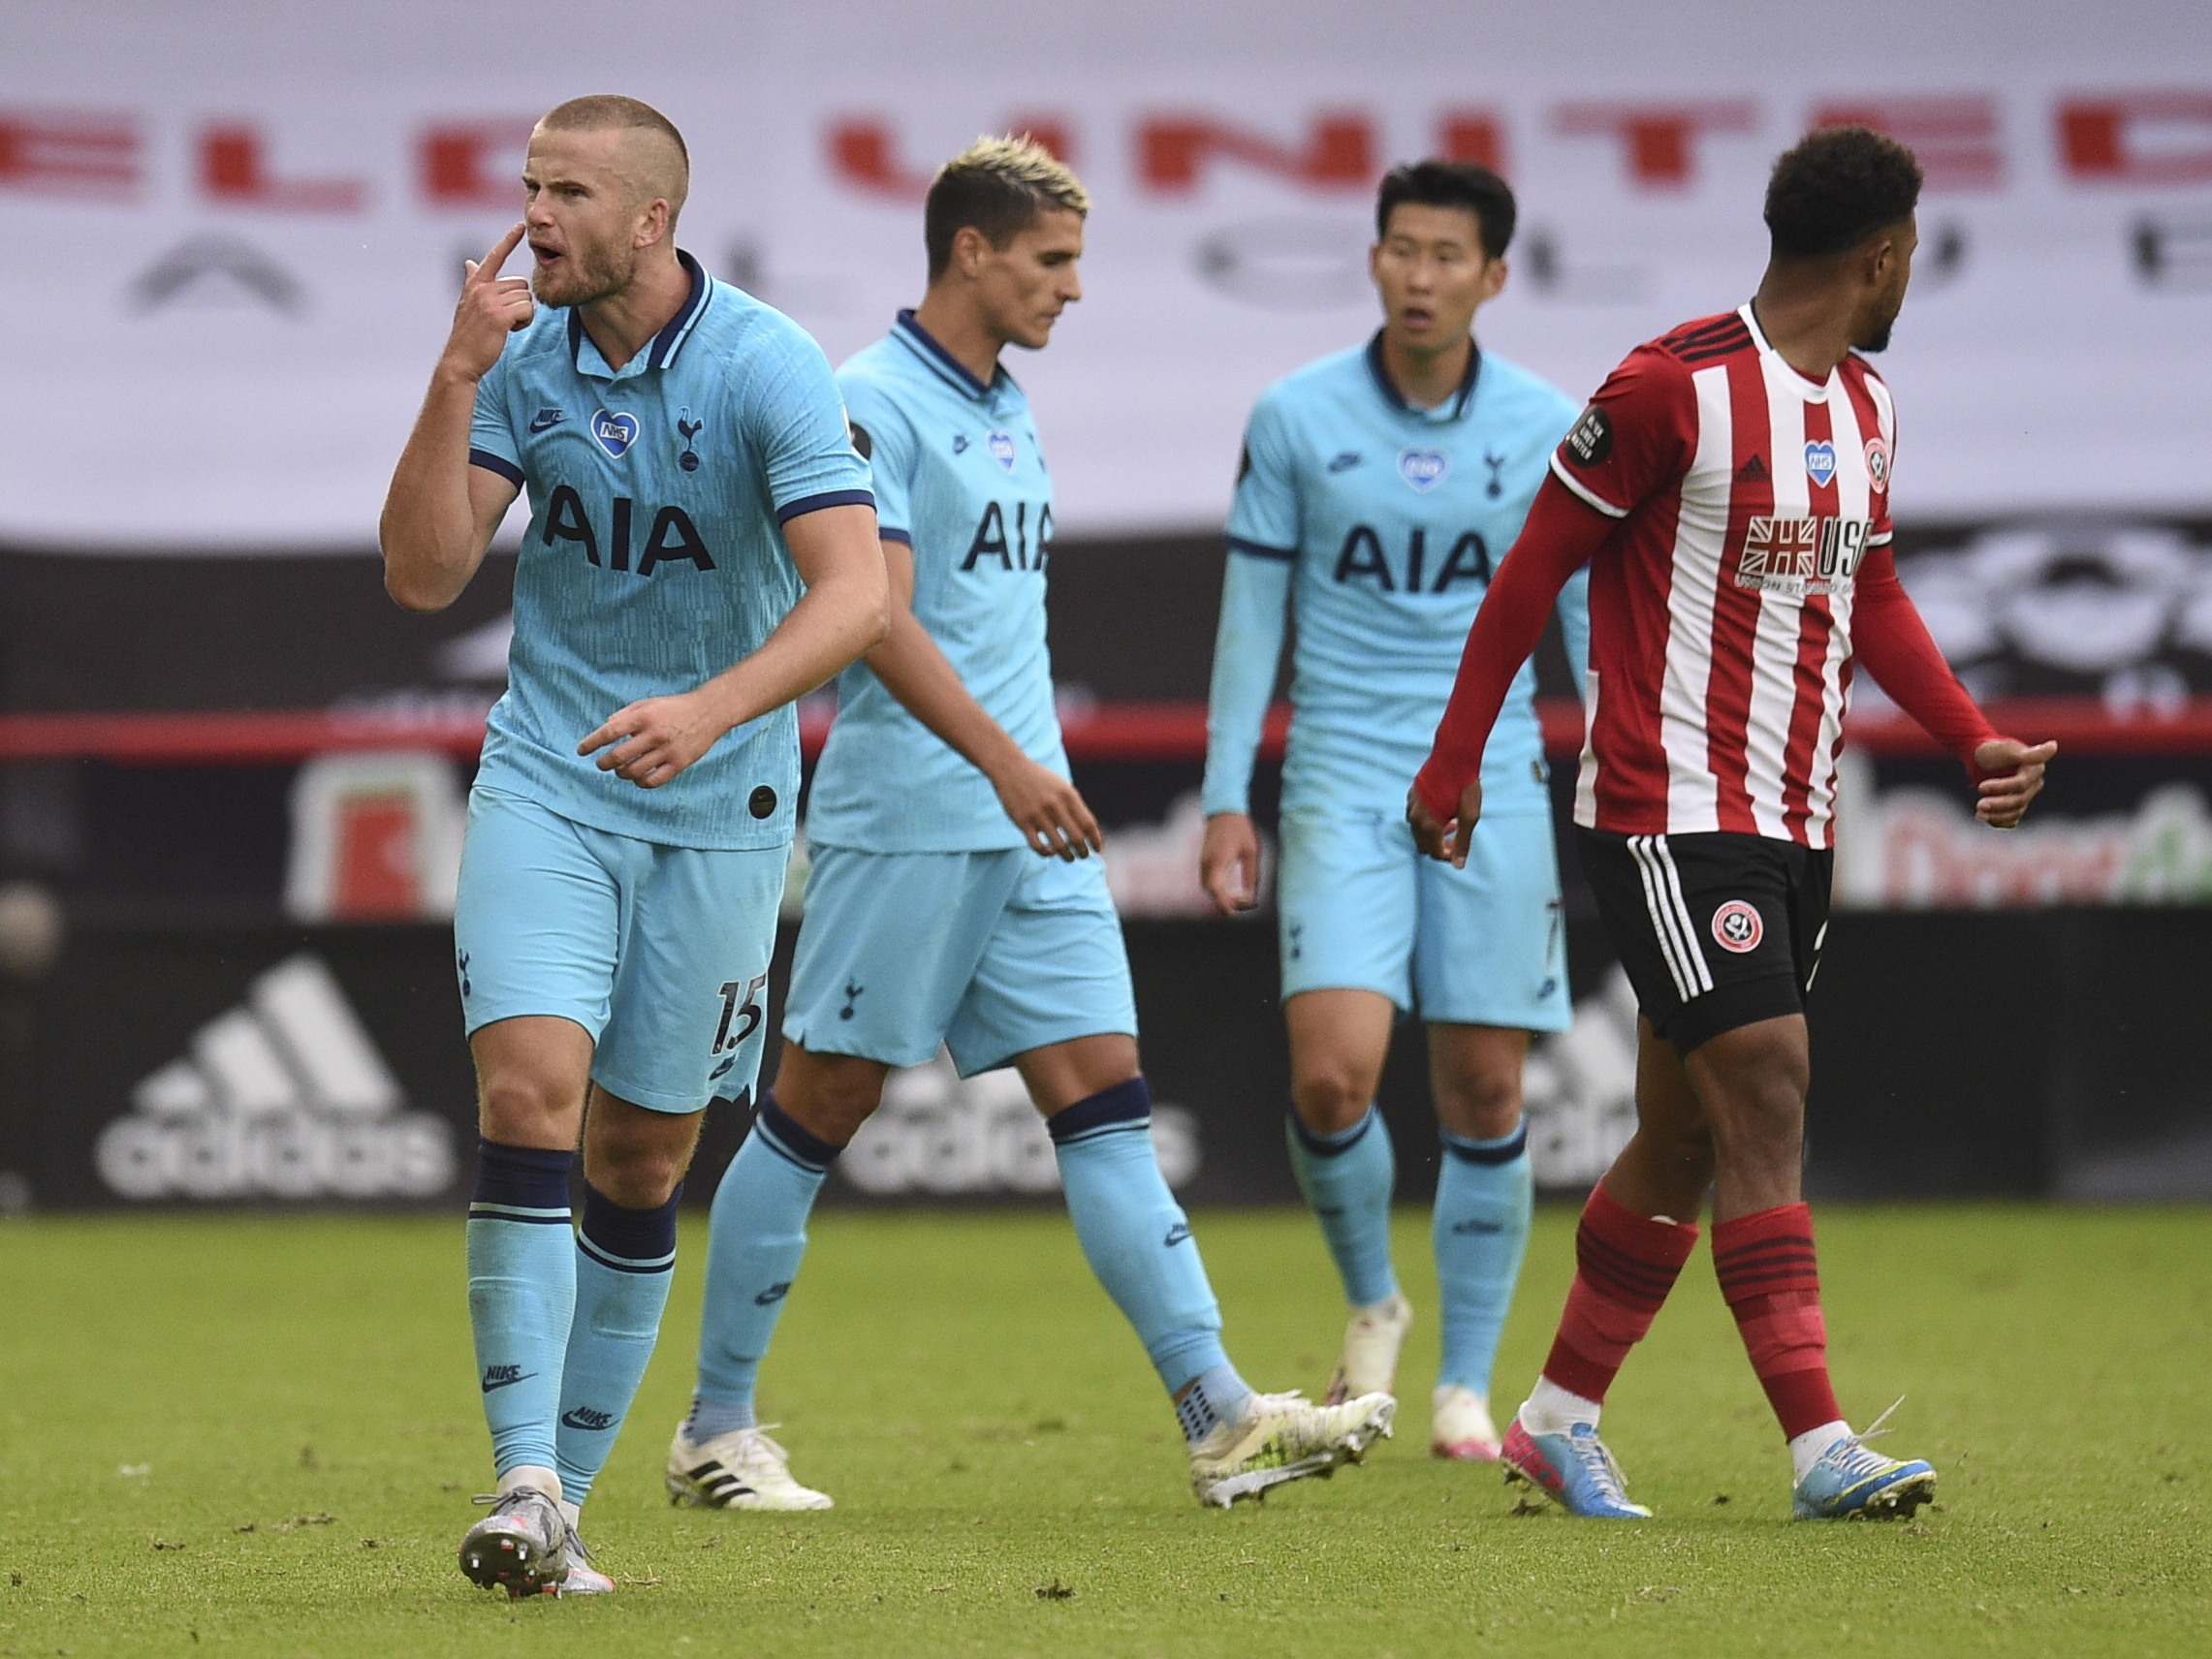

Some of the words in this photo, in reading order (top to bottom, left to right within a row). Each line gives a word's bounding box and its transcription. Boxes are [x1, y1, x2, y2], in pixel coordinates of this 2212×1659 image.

[601, 423, 627, 440] NHS
[1570, 433, 1593, 460] MATTER
[1811, 455, 1831, 469] NHS
[542, 485, 716, 577] AIA
[1335, 523, 1493, 594] AIA
[711, 972, 767, 1056] 15
[93, 1107, 458, 1202] adidas
[839, 1103, 1202, 1196] adids
[487, 1364, 521, 1381] NIKE
[574, 1406, 613, 1427] NIKE
